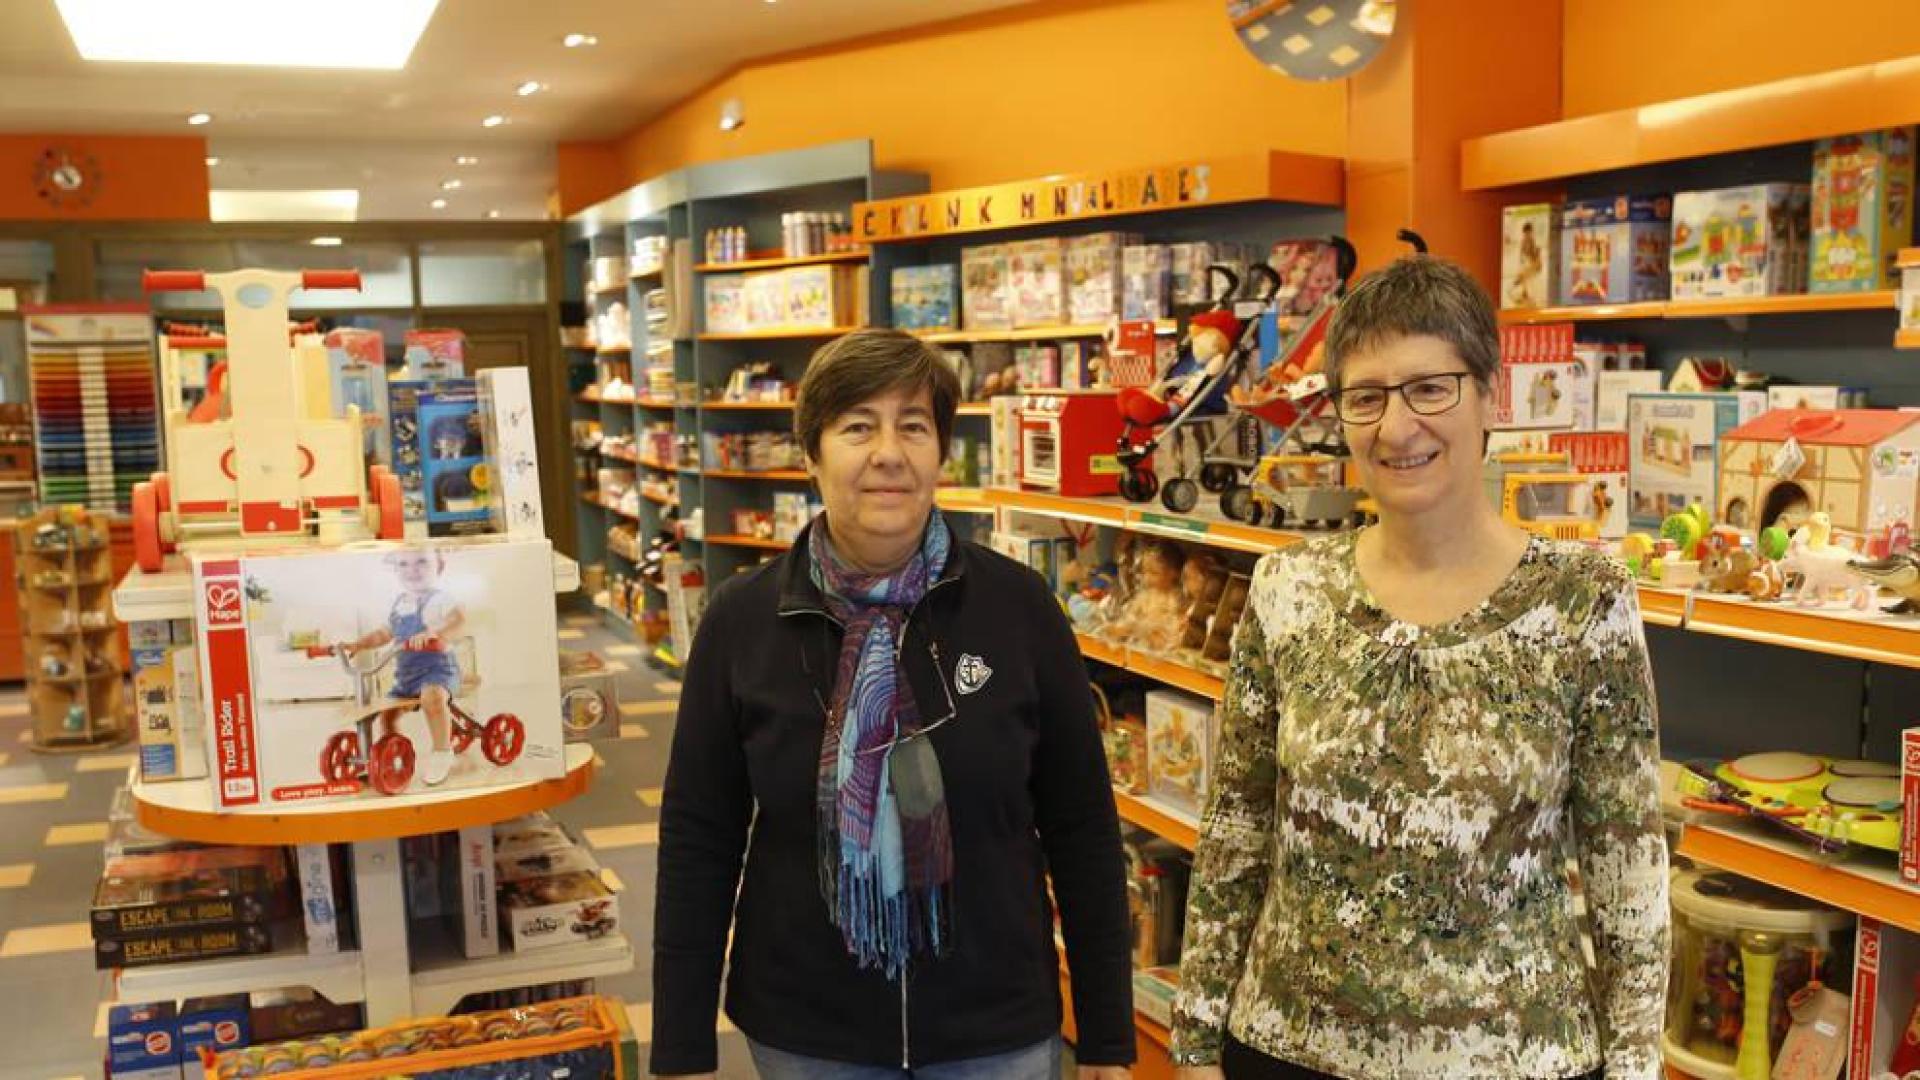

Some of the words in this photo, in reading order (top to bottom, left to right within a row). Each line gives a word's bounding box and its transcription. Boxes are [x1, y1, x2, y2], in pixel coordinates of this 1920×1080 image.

[220, 699, 234, 737] Rider
[120, 905, 168, 929] ESCAPE
[124, 937, 171, 961] ESCAPE
